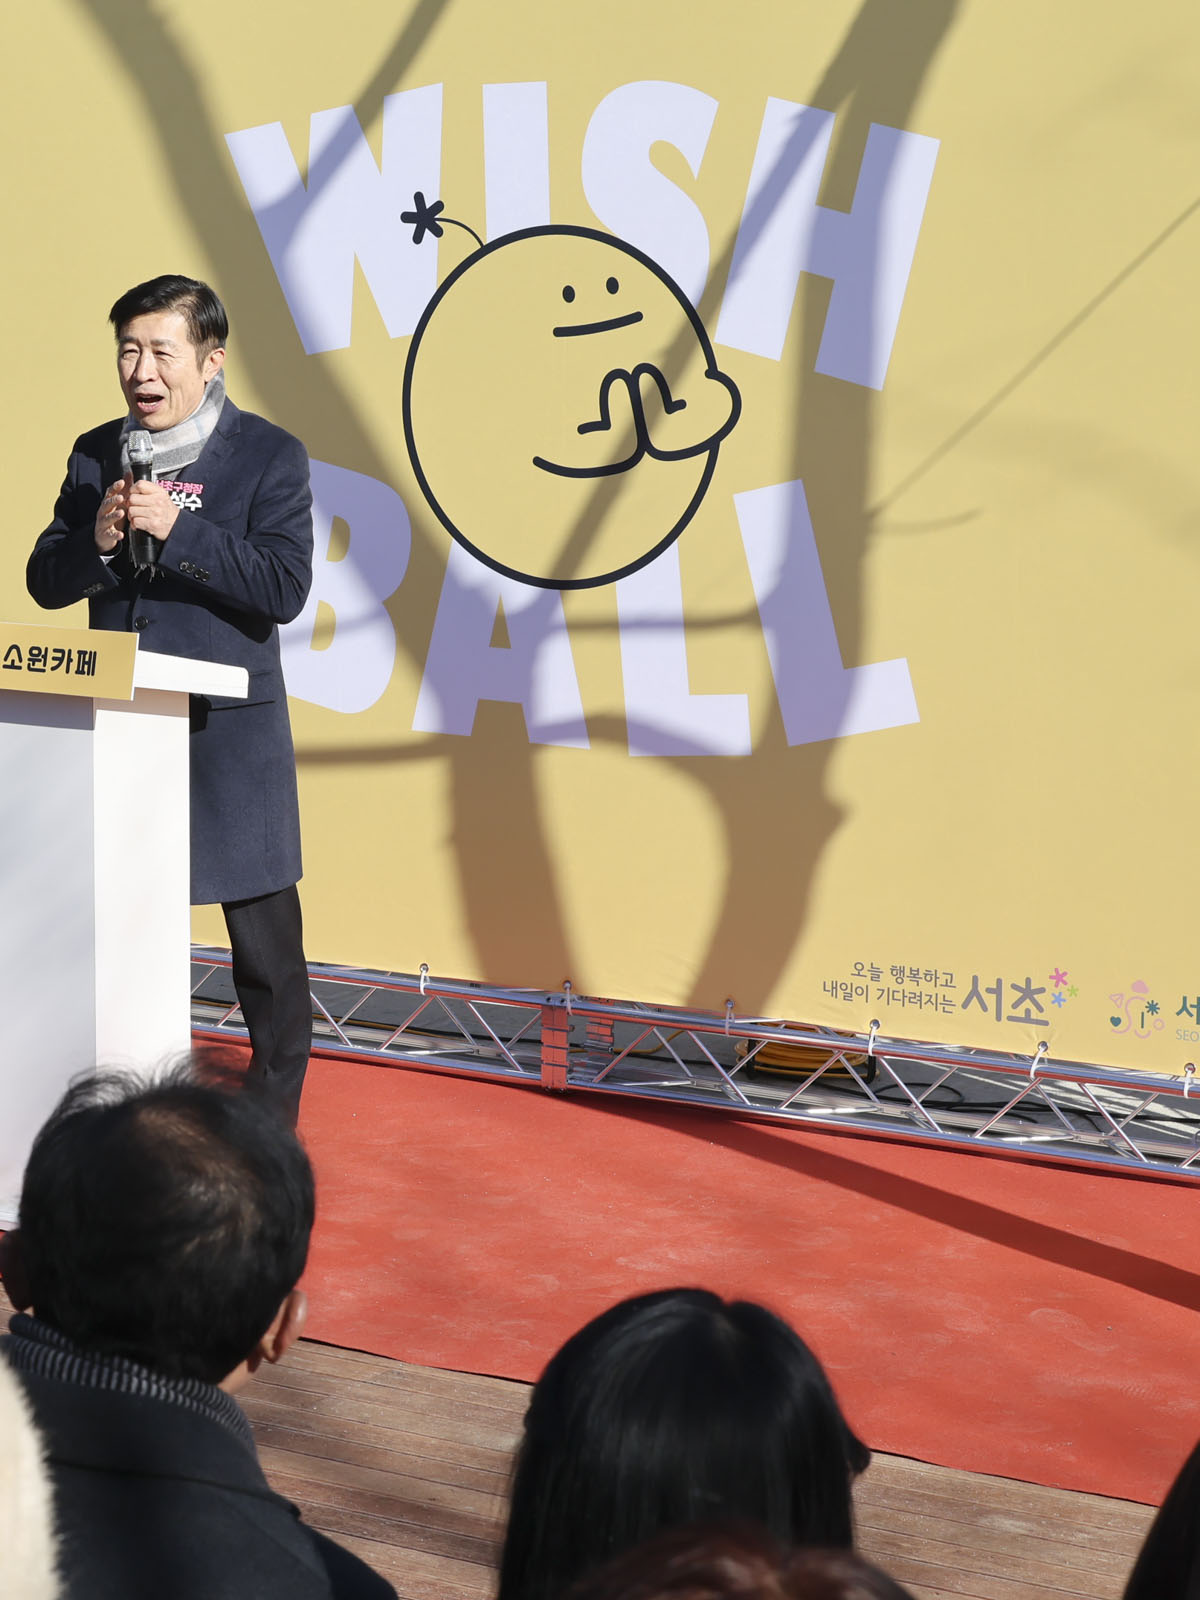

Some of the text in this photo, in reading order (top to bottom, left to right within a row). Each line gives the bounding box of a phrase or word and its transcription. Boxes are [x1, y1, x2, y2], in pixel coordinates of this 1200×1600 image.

[224, 79, 941, 392] WISH
[280, 457, 921, 757] BALL
[2, 643, 98, 678] 소원카페
[822, 980, 957, 1014] 내일이 기다려지는
[850, 961, 957, 989] 오늘 행복하고
[960, 974, 1050, 1027] 서초
